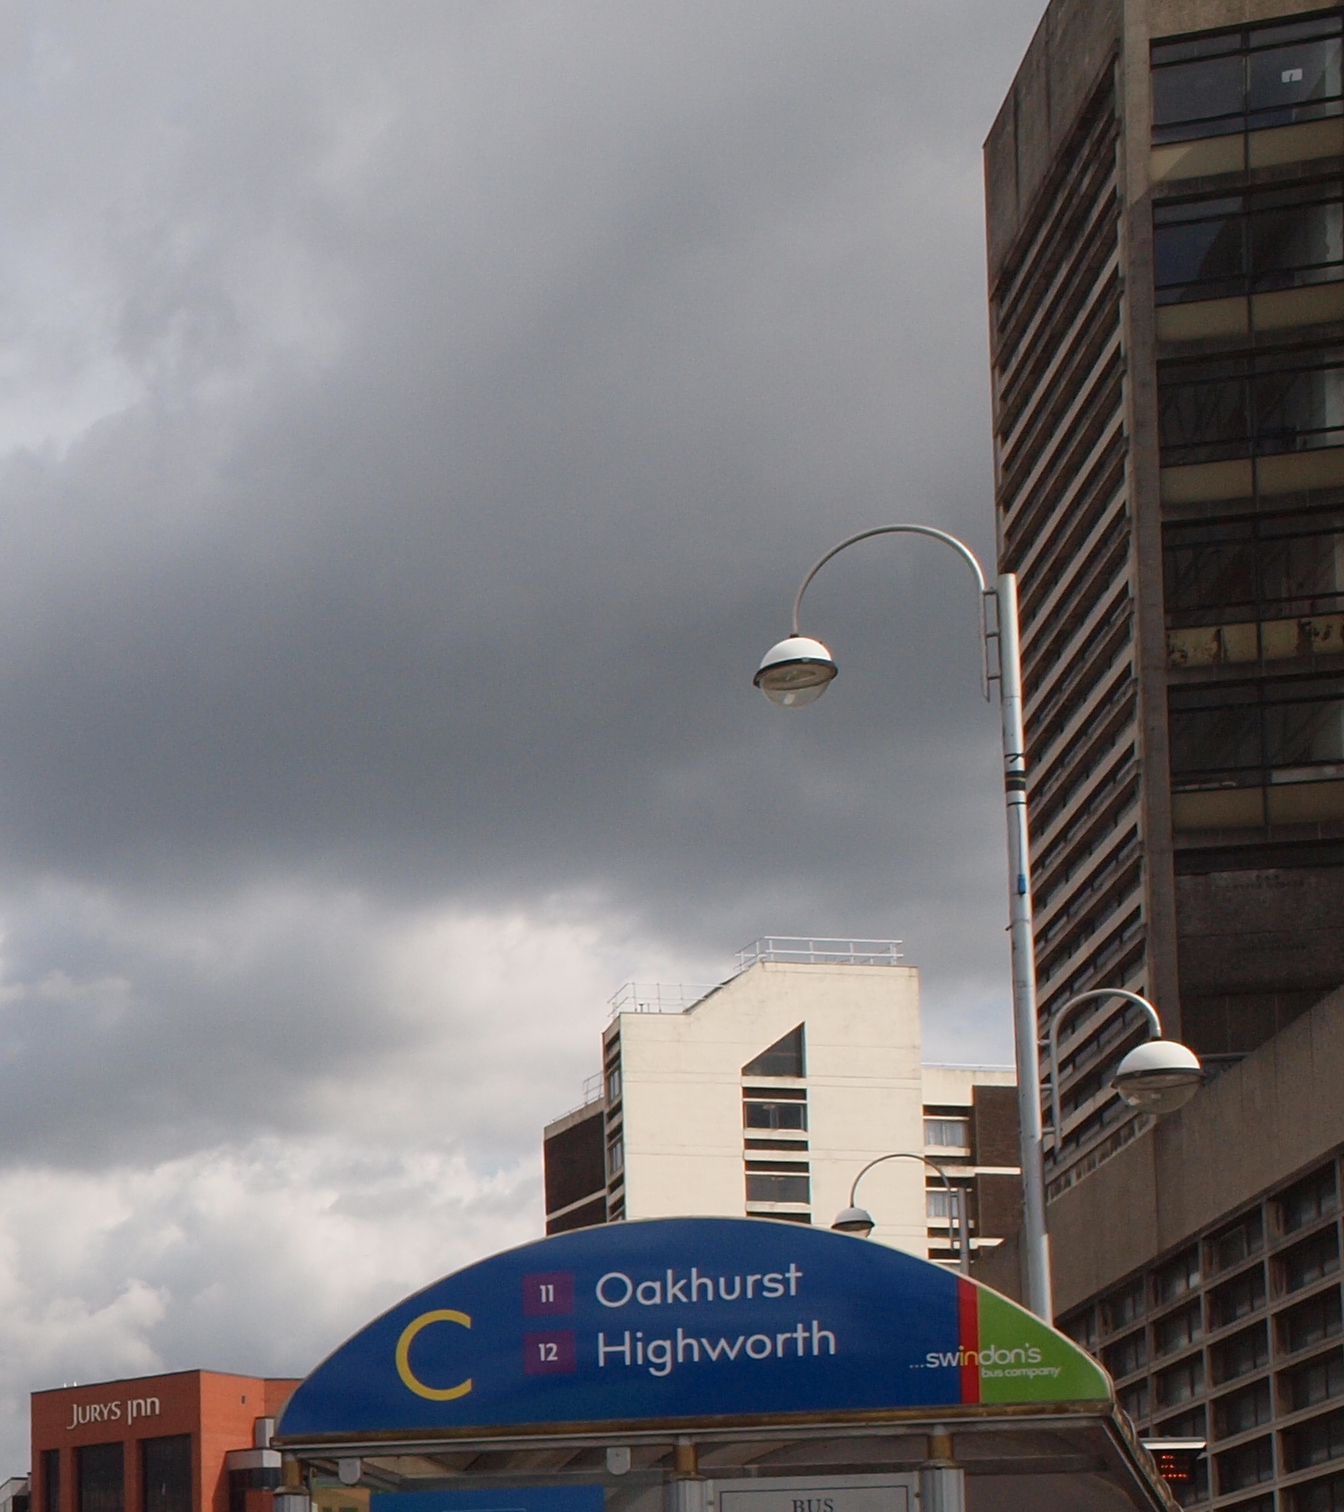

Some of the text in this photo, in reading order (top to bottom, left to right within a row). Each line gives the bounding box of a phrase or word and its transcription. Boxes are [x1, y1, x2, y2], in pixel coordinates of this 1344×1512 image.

[538, 1262, 803, 1308] 11 Oakhurst
[395, 1308, 473, 1401] C
[537, 1319, 837, 1377] 12 Highworth
[1003, 1365, 1061, 1379] company
